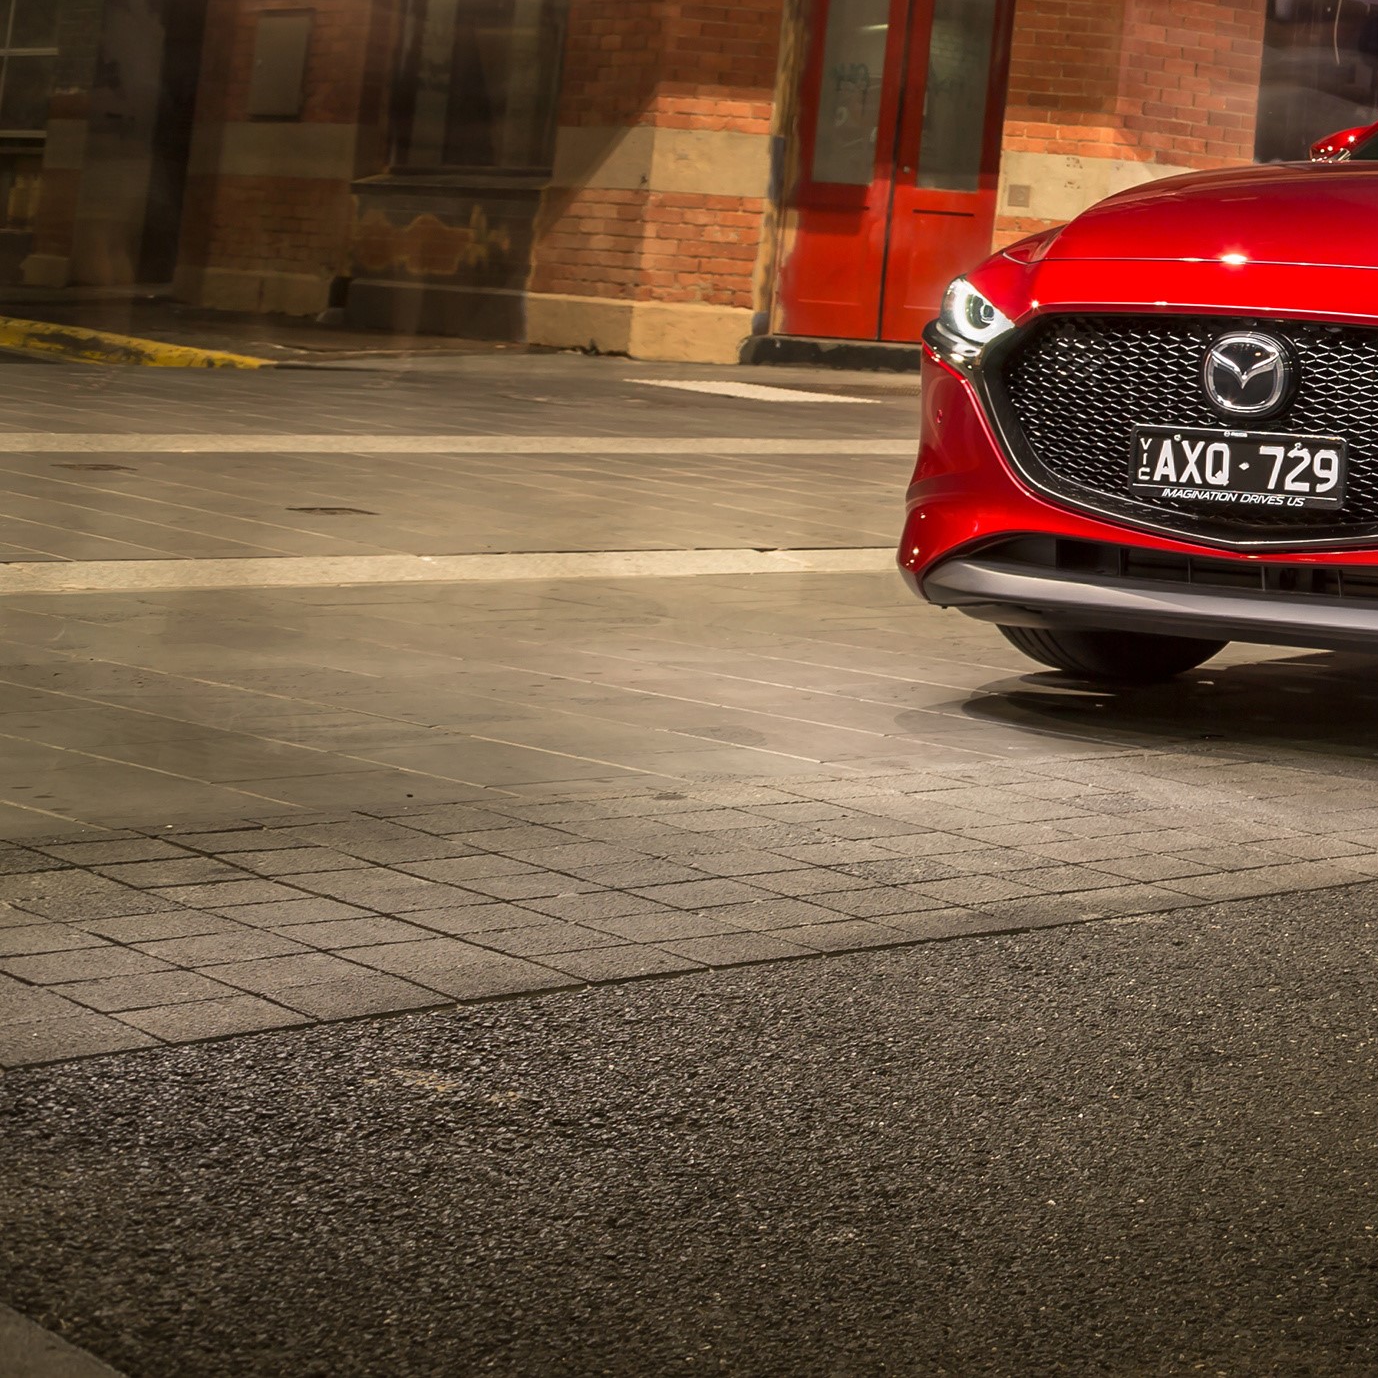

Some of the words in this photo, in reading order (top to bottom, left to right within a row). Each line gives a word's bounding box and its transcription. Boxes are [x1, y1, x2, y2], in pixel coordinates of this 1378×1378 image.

[1161, 487, 1237, 503] IMAGINATION
[1240, 493, 1284, 506] DRIVES
[1286, 496, 1306, 507] US
